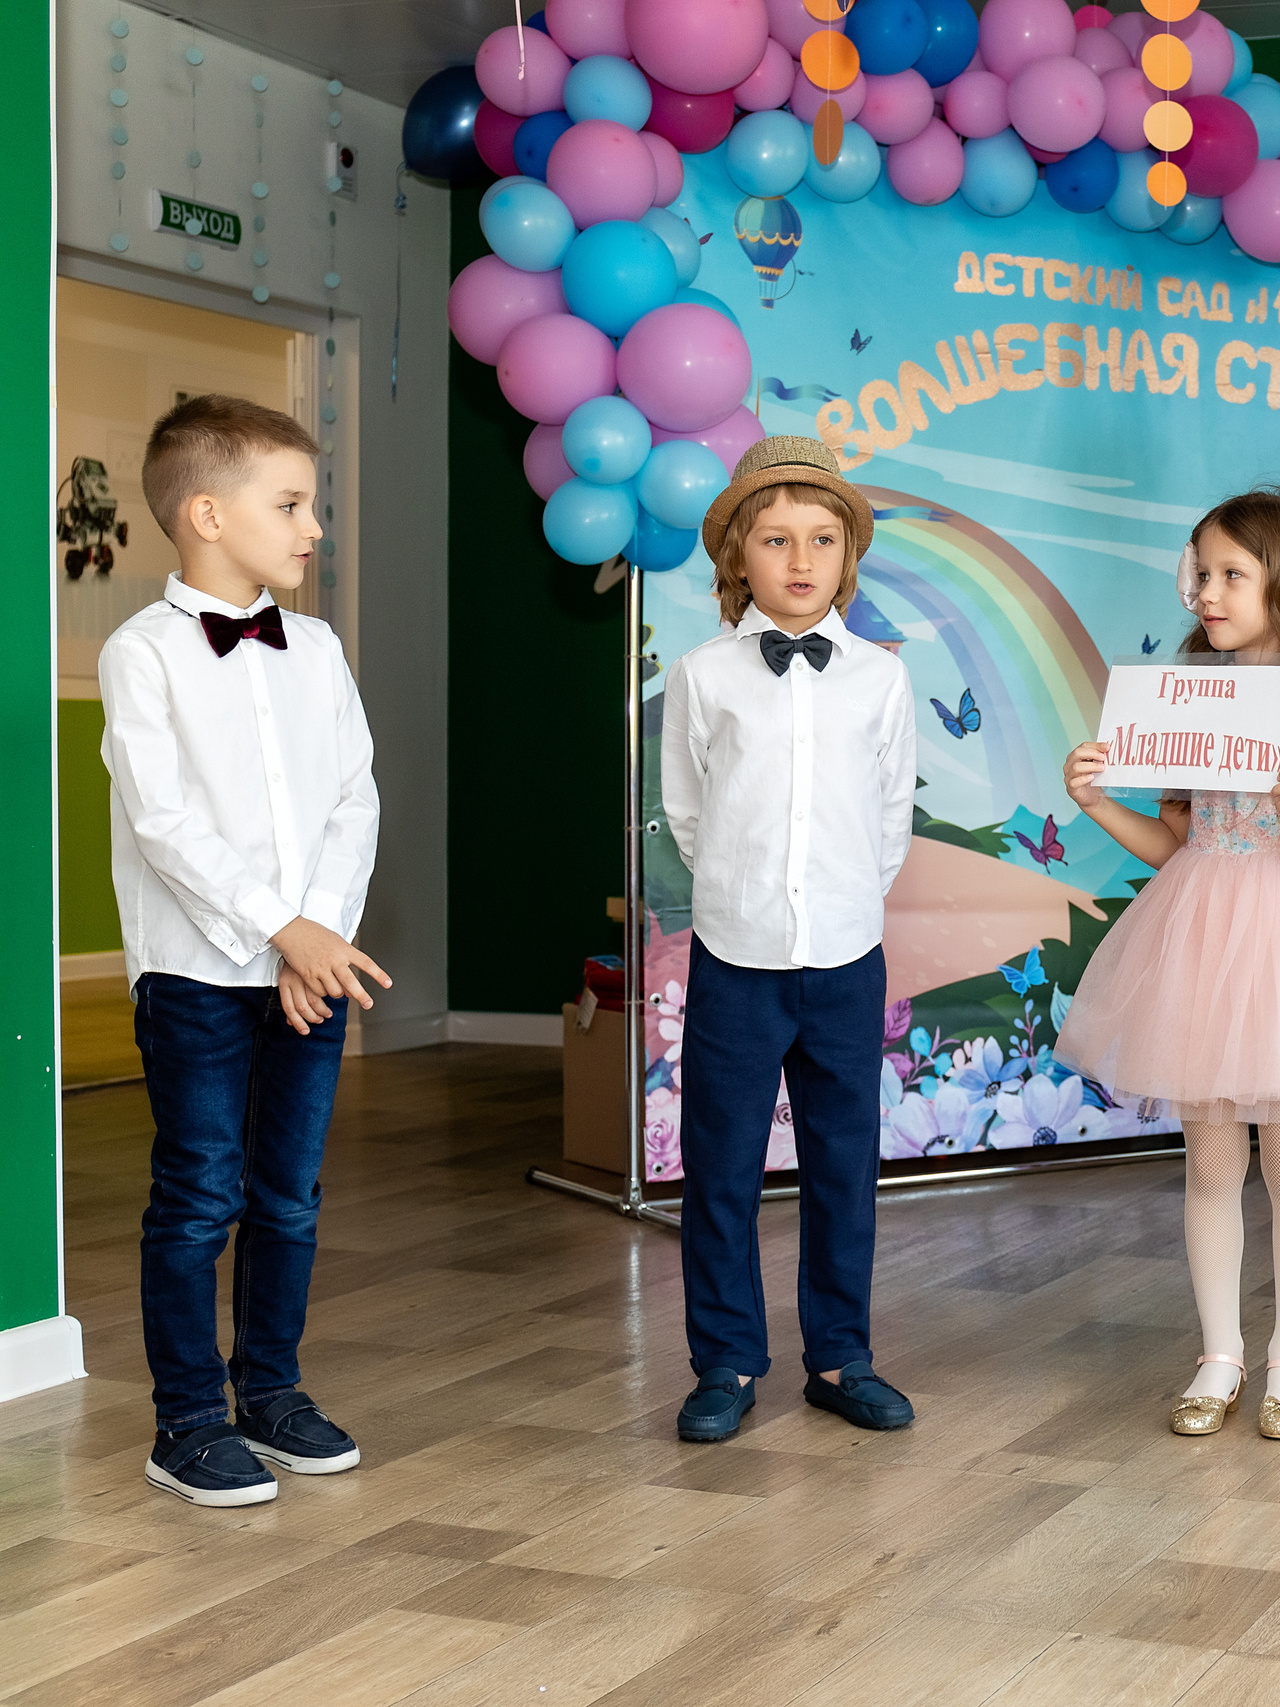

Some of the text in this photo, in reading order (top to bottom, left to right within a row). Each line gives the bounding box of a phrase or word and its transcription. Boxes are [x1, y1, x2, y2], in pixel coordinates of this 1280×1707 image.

[953, 251, 1142, 312] ДЕТСКИЙ
[1157, 276, 1233, 323] САД
[815, 322, 1200, 472] ВОЛШЕБНАЯ
[1157, 671, 1236, 705] Группа
